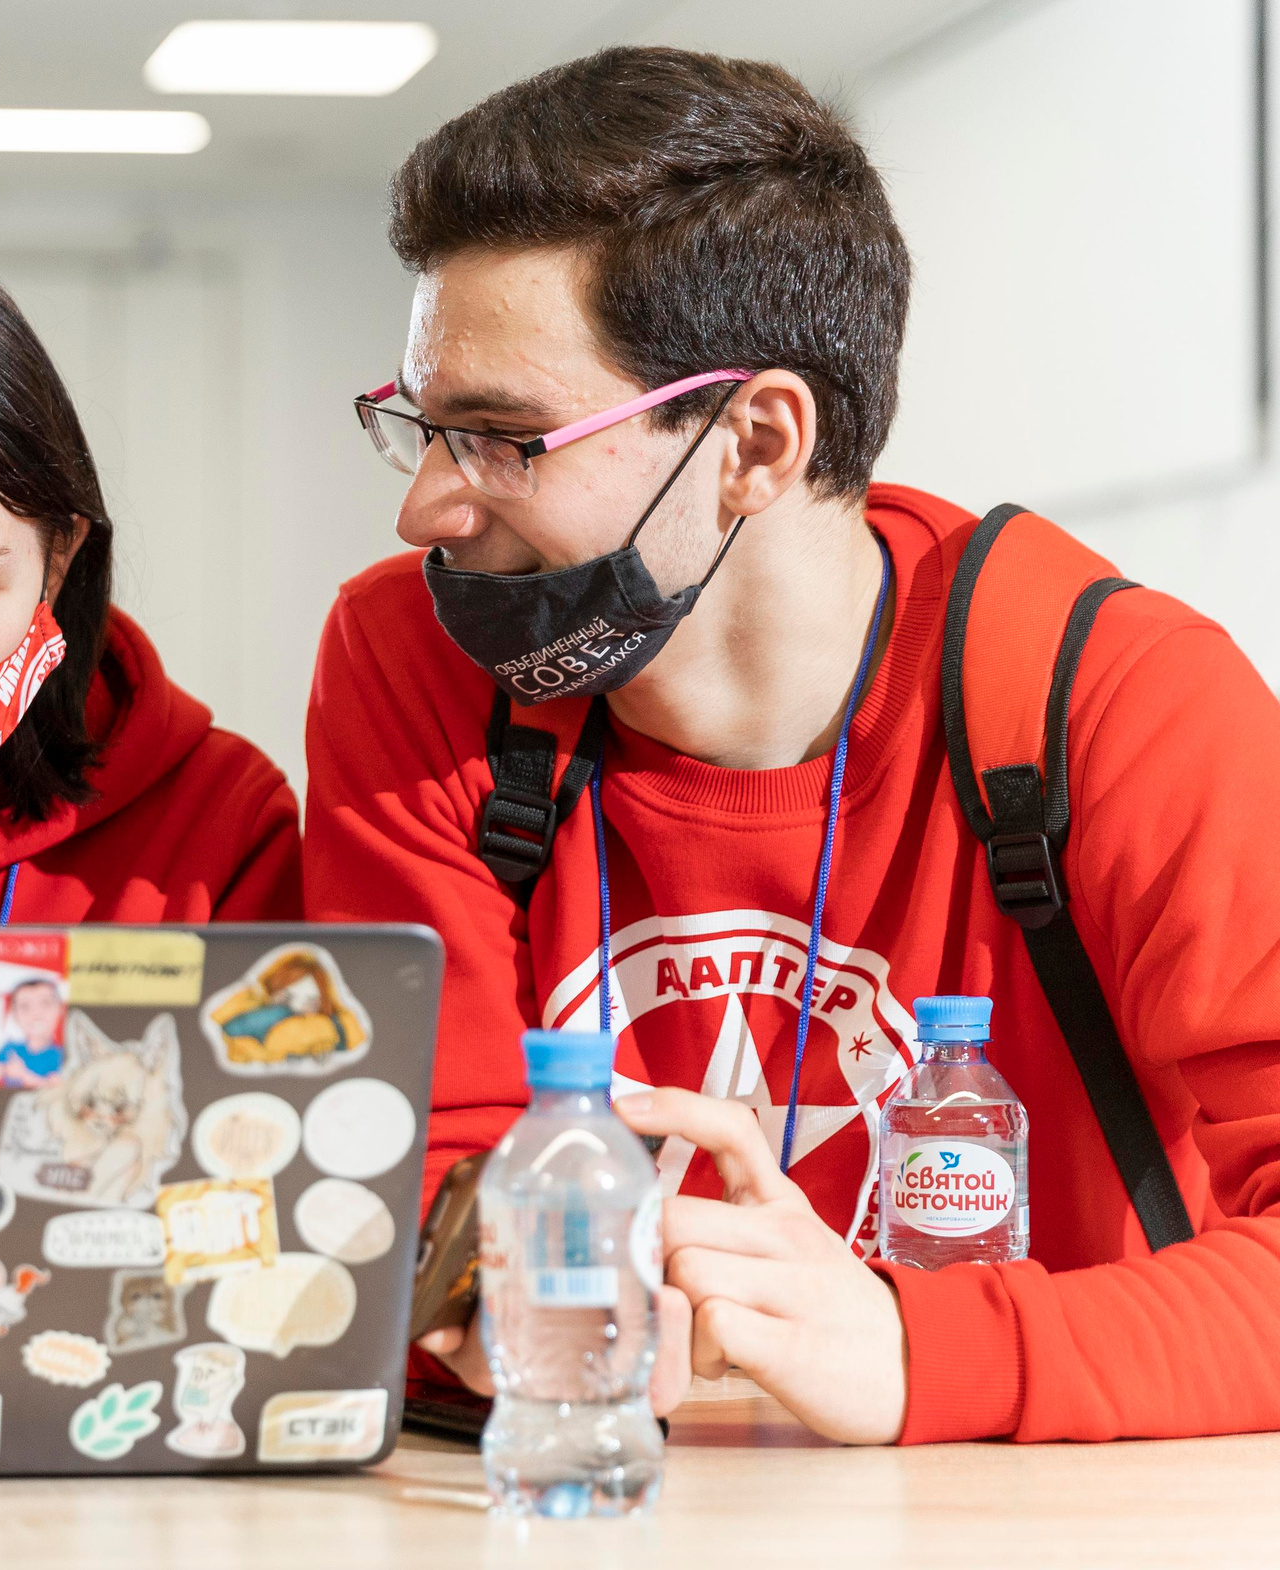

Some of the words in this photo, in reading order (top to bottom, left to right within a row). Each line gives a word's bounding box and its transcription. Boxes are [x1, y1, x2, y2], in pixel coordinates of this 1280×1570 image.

[495, 616, 610, 676] ОБЪЕДИНЕННЫЙ
[511, 627, 625, 694] СОВЕТ
[287, 1412, 357, 1438] СТЭК
